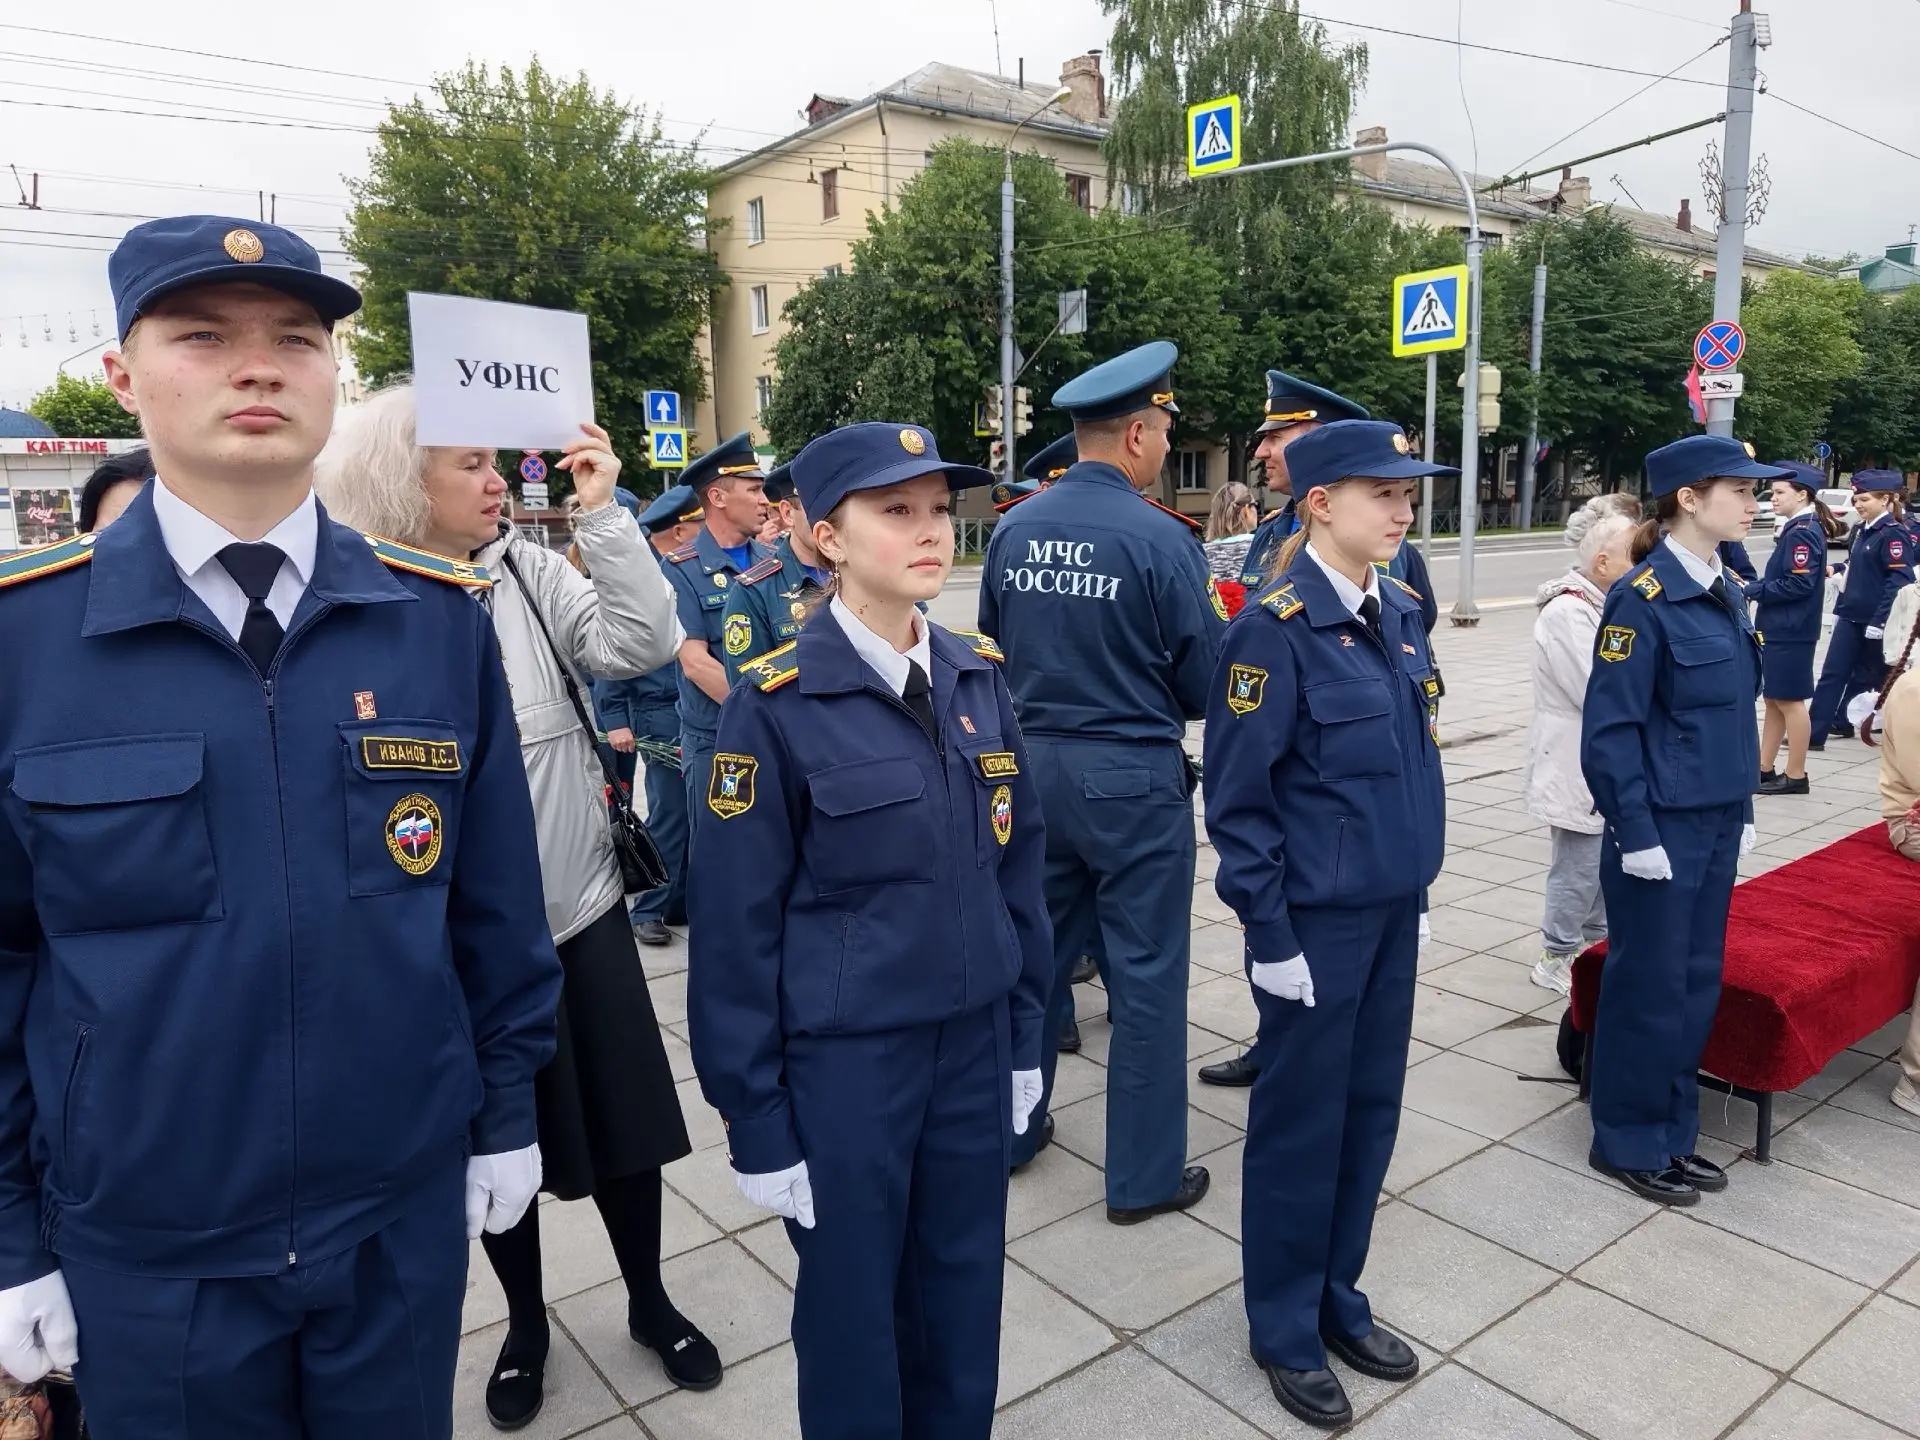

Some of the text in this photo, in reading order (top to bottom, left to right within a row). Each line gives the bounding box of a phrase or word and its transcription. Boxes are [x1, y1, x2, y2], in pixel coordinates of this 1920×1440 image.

[454, 358, 560, 393] УФНС
[26, 440, 108, 453] KAIF TIME
[1025, 539, 1094, 567] МЧС
[1002, 567, 1122, 601] РОССИИ
[752, 660, 782, 681] КК
[379, 744, 453, 767] ИВАНОВ Д.С.
